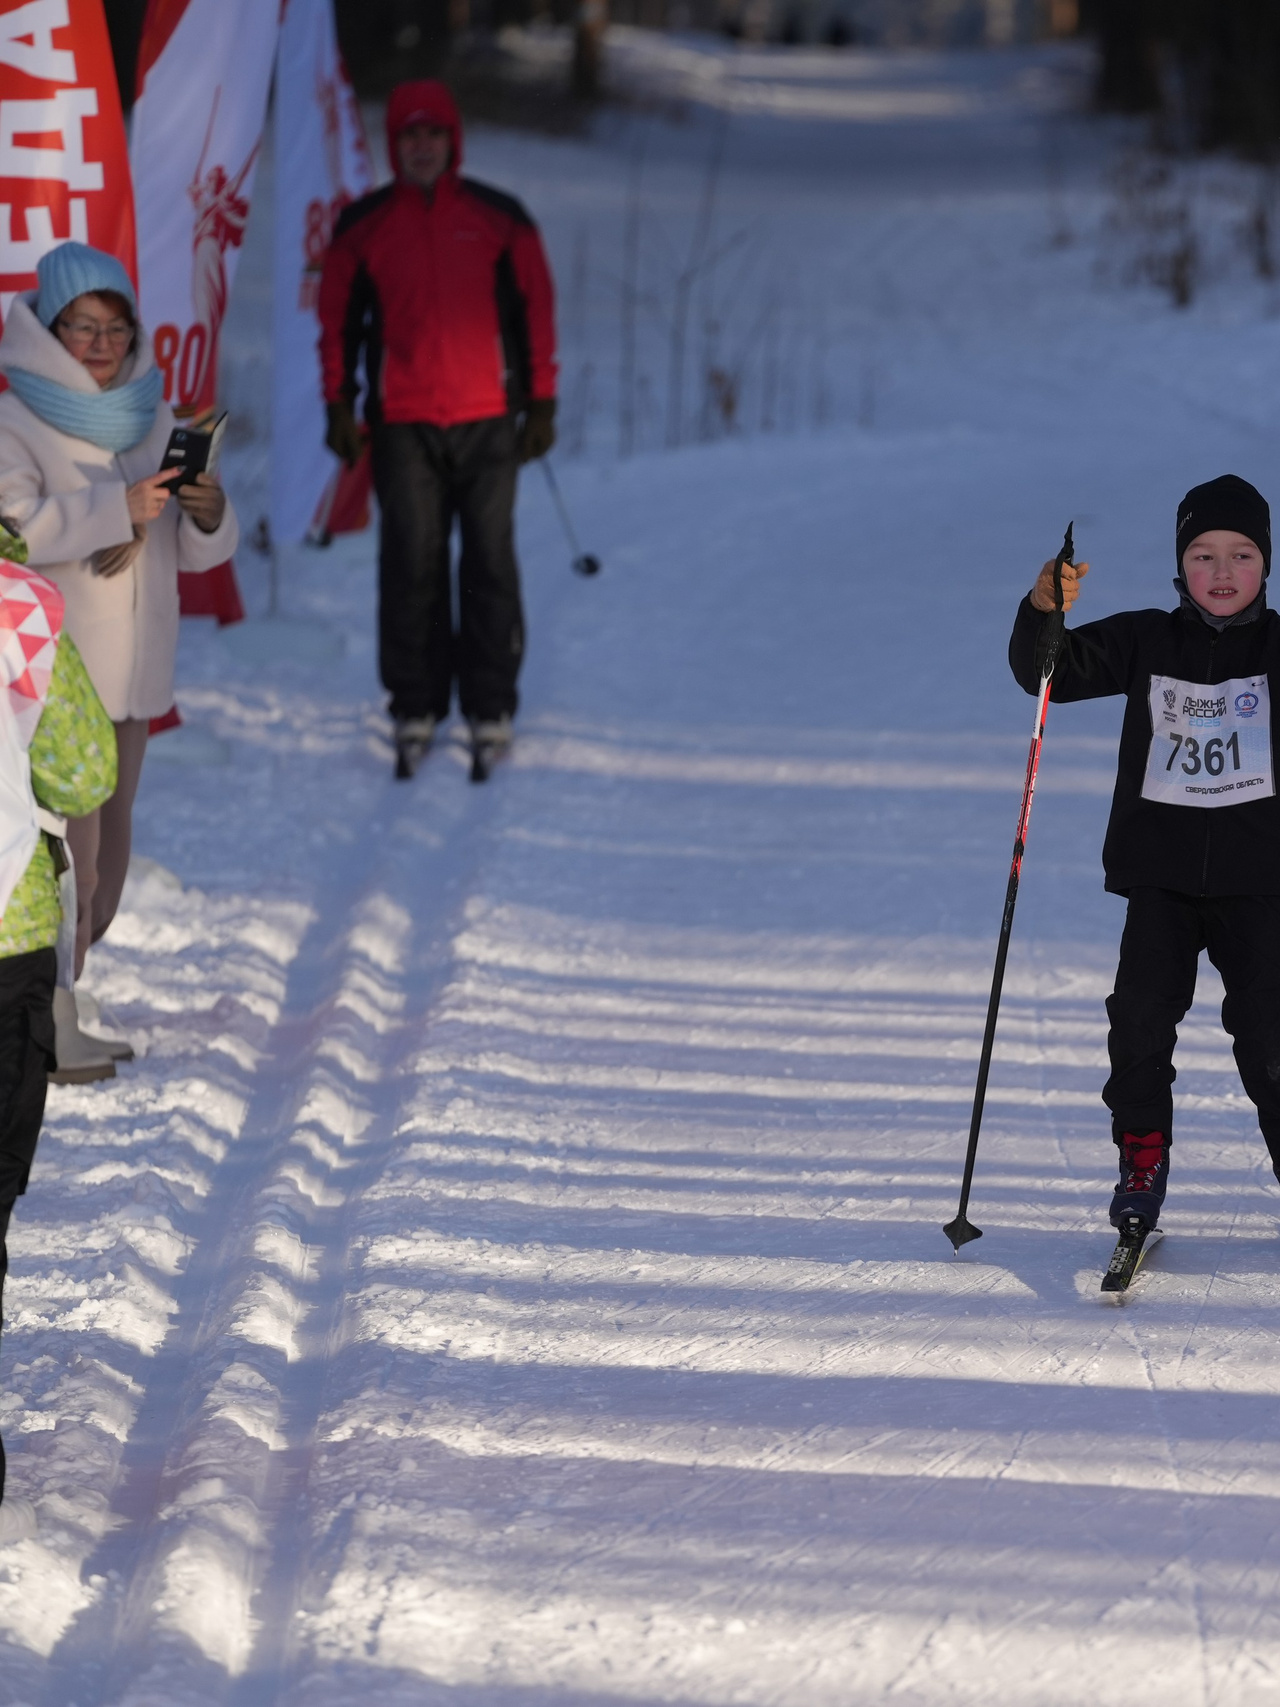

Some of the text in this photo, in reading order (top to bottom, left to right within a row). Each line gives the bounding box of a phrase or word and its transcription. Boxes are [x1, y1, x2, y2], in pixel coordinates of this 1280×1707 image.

[1184, 696, 1226, 708] ЛЫЖНЯ
[1182, 705, 1227, 718] РОССИИ
[1188, 717, 1221, 727] 2025
[1165, 731, 1241, 776] 7361
[1185, 777, 1265, 795] СВЕРДЛОВСКАЯ ОБЛАСТЬ
